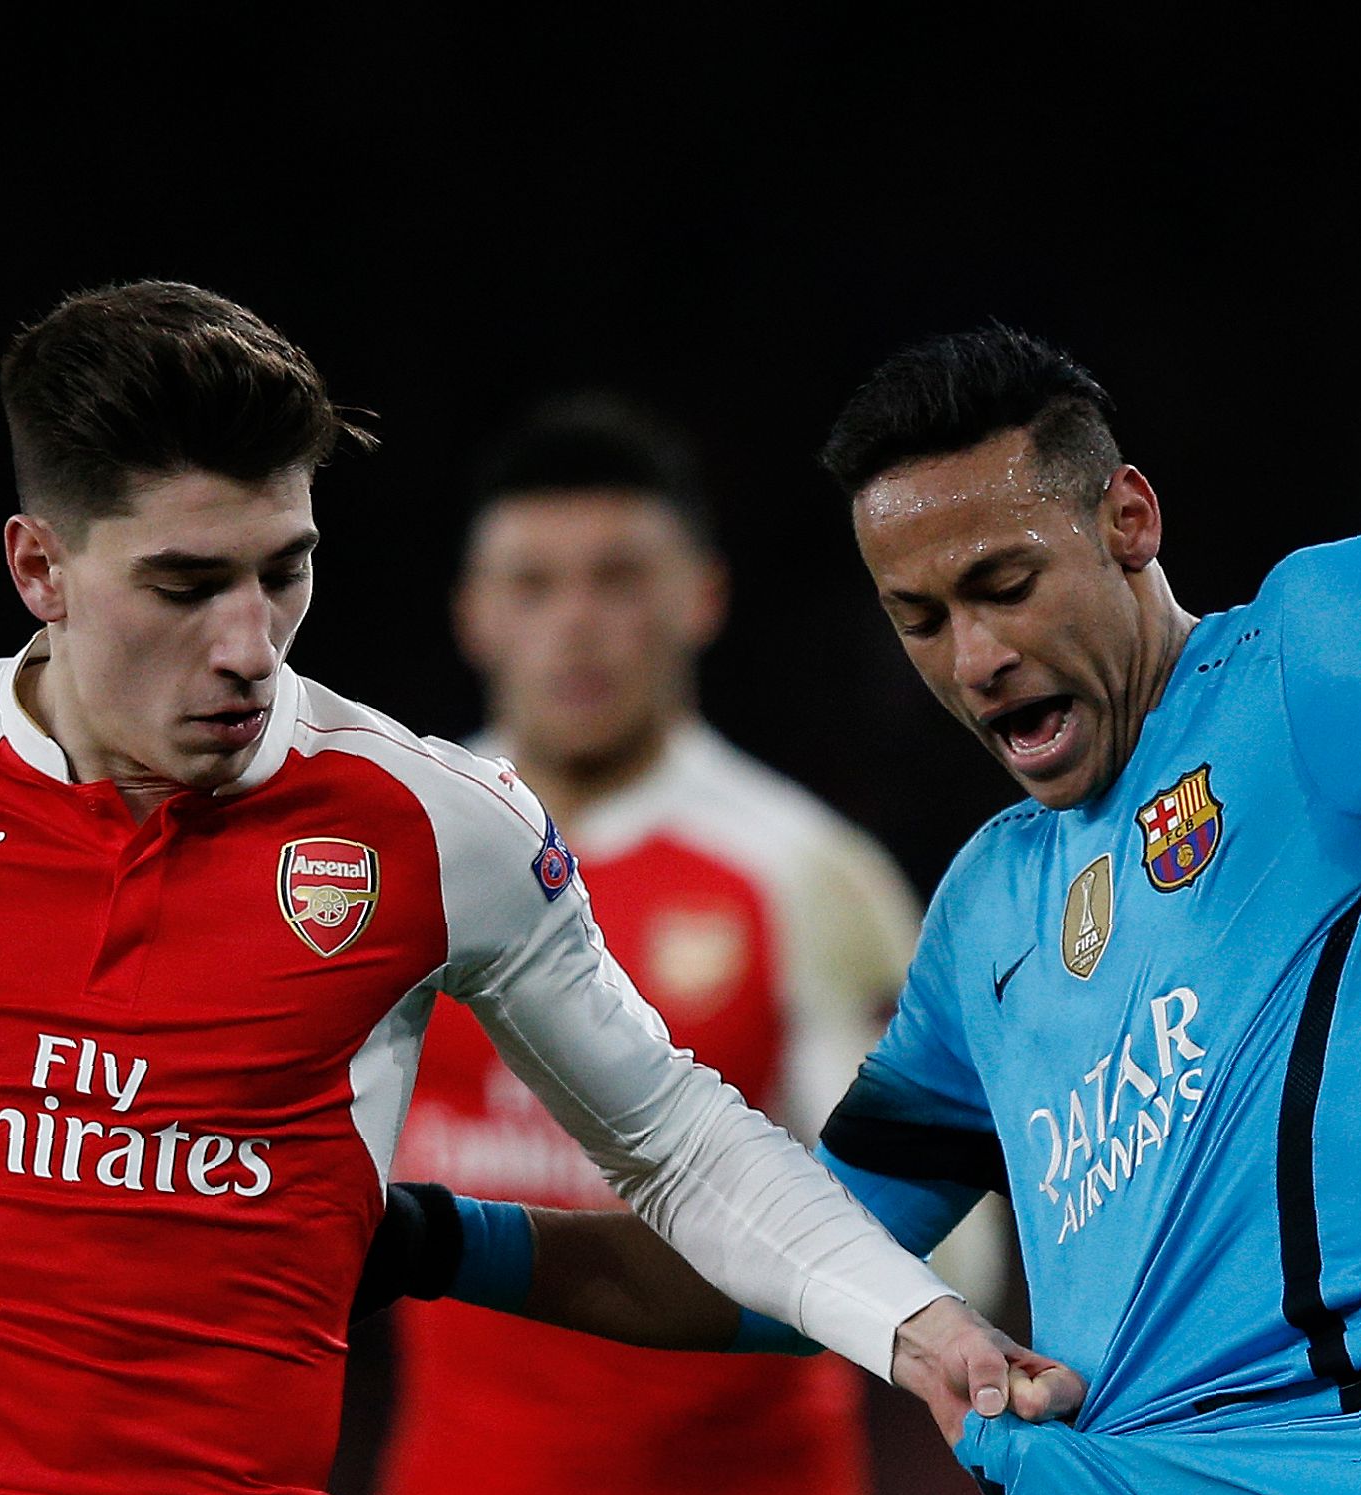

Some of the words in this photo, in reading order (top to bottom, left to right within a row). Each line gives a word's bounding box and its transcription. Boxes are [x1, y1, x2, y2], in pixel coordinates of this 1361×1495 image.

[1166, 819, 1195, 846] FCB
[291, 855, 367, 878] Arsenal
[1075, 929, 1099, 956] FIFA
[32, 1033, 148, 1112] Fly
[1028, 987, 1207, 1204] QATAR
[1057, 1068, 1204, 1245] AIRWAYS
